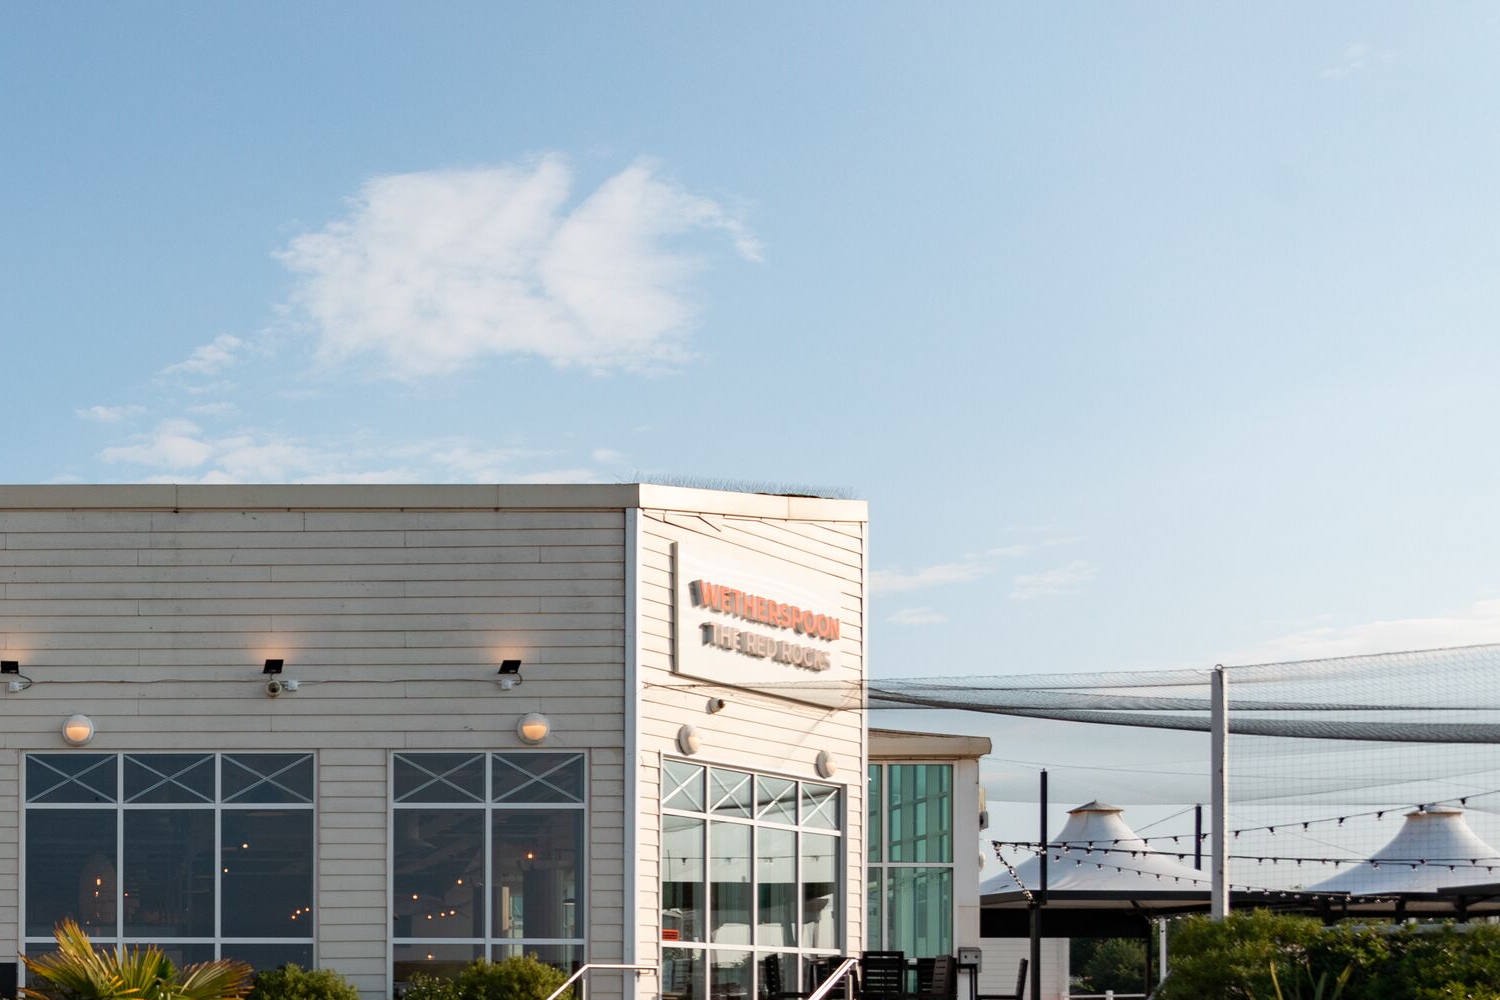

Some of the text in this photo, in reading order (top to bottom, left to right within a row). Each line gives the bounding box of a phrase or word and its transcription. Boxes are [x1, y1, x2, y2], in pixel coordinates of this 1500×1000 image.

[689, 579, 840, 641] WETHERSPOON
[700, 622, 832, 672] THE RED ROCKS
